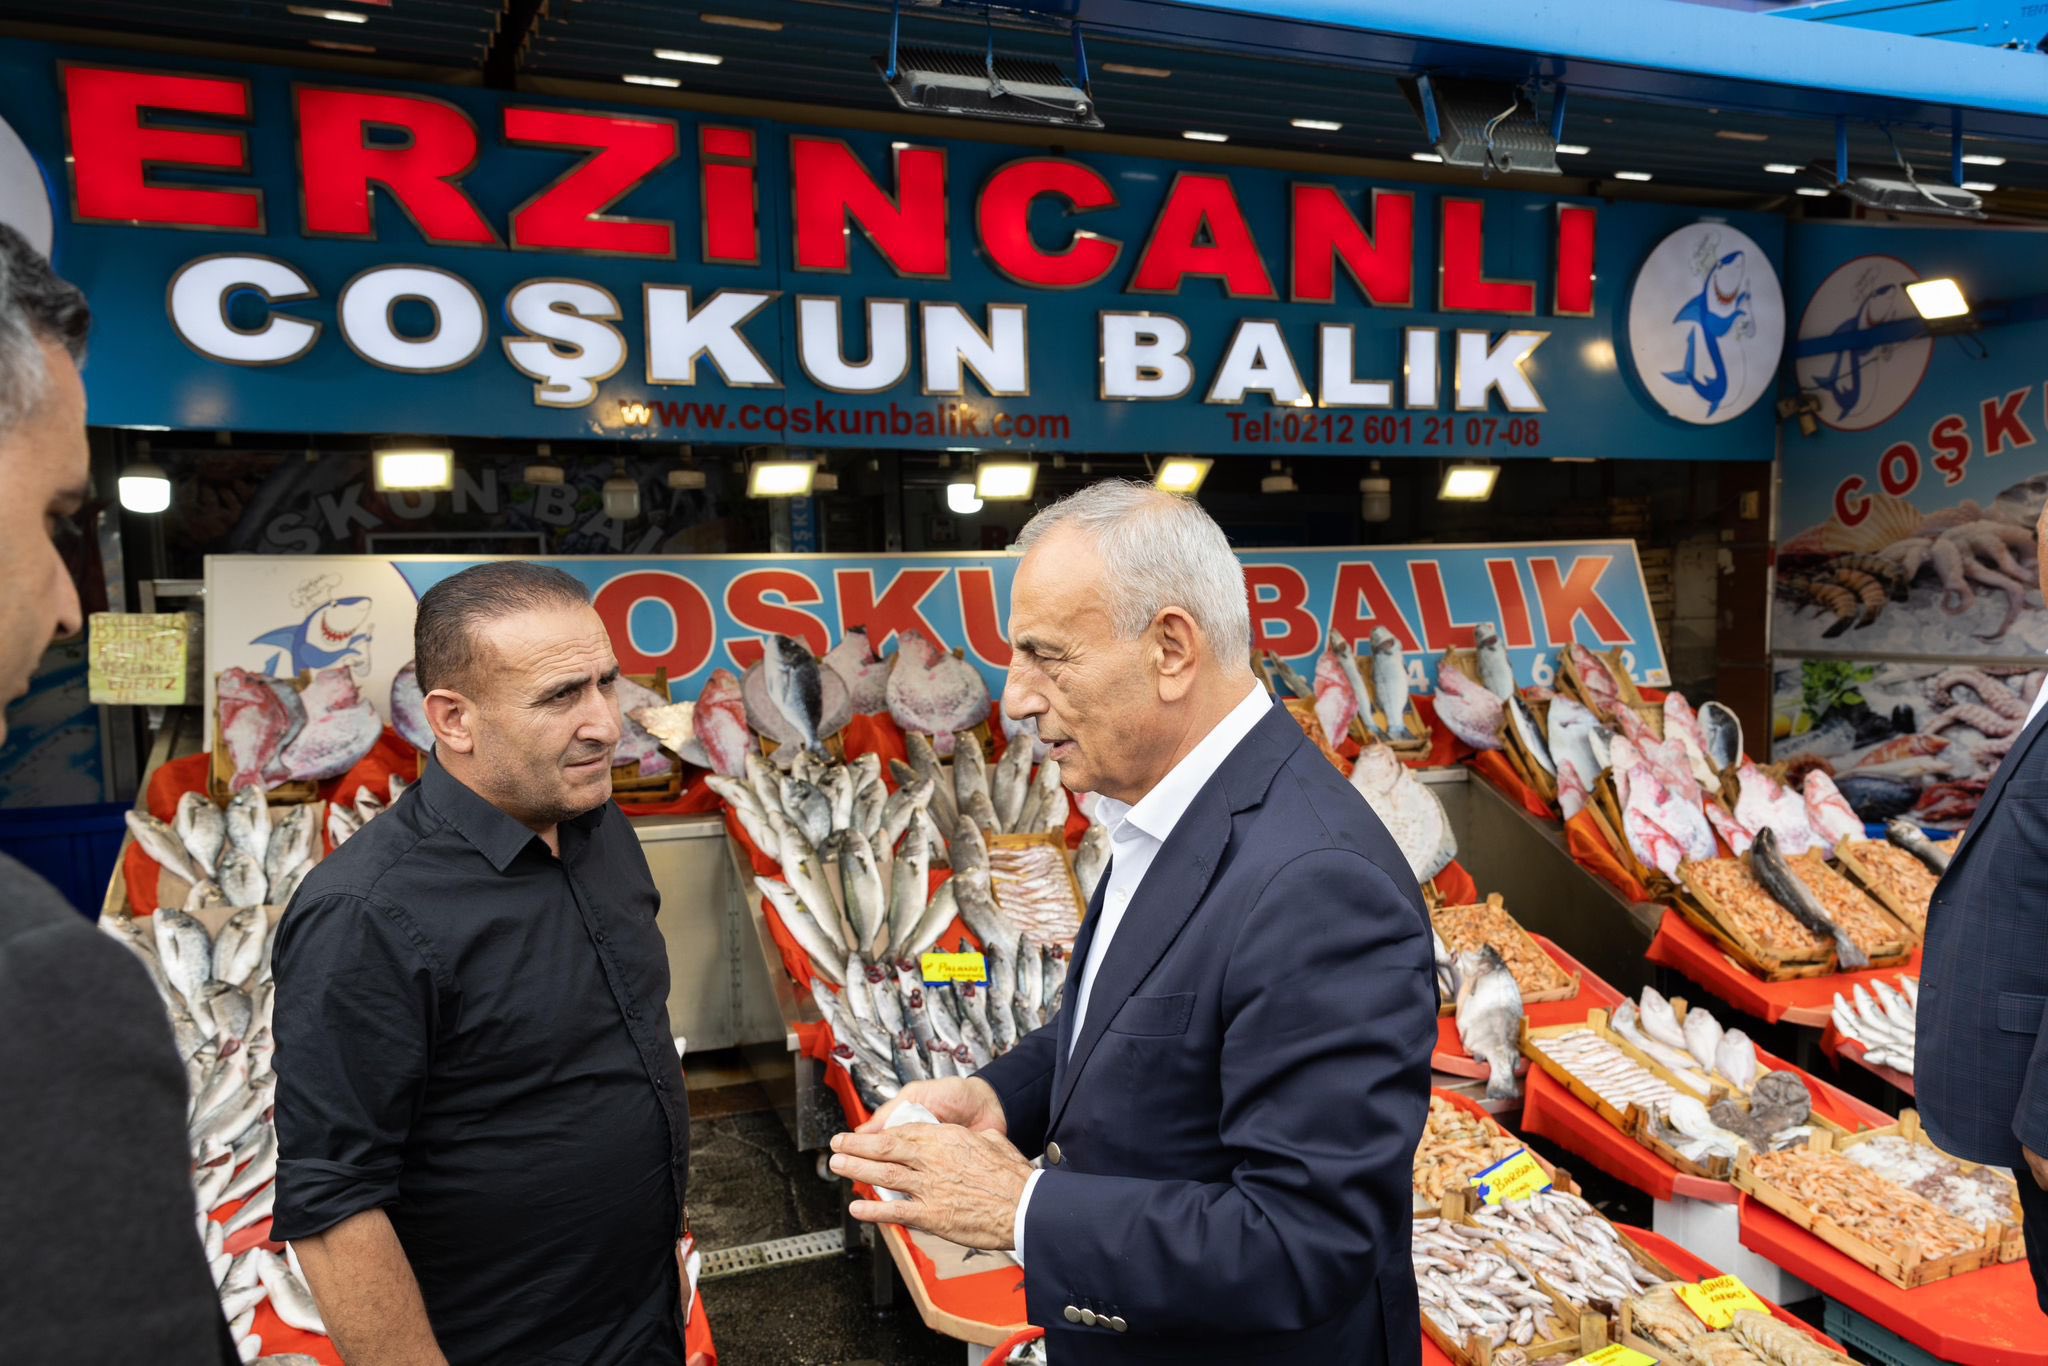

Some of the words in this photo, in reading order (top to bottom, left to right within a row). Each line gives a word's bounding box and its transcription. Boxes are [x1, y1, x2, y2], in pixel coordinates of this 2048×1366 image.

[165, 251, 1030, 408] COŞKUN
[1099, 310, 1551, 413] BALIK
[619, 400, 1071, 440] www.coskunbalik.com
[1226, 412, 1355, 444] Tel:0212
[1363, 415, 1413, 445] 601
[1423, 416, 1455, 445] 21
[1465, 418, 1541, 447] 07-08
[1834, 380, 2048, 528] COŞK
[1246, 555, 1635, 660] BALIK
